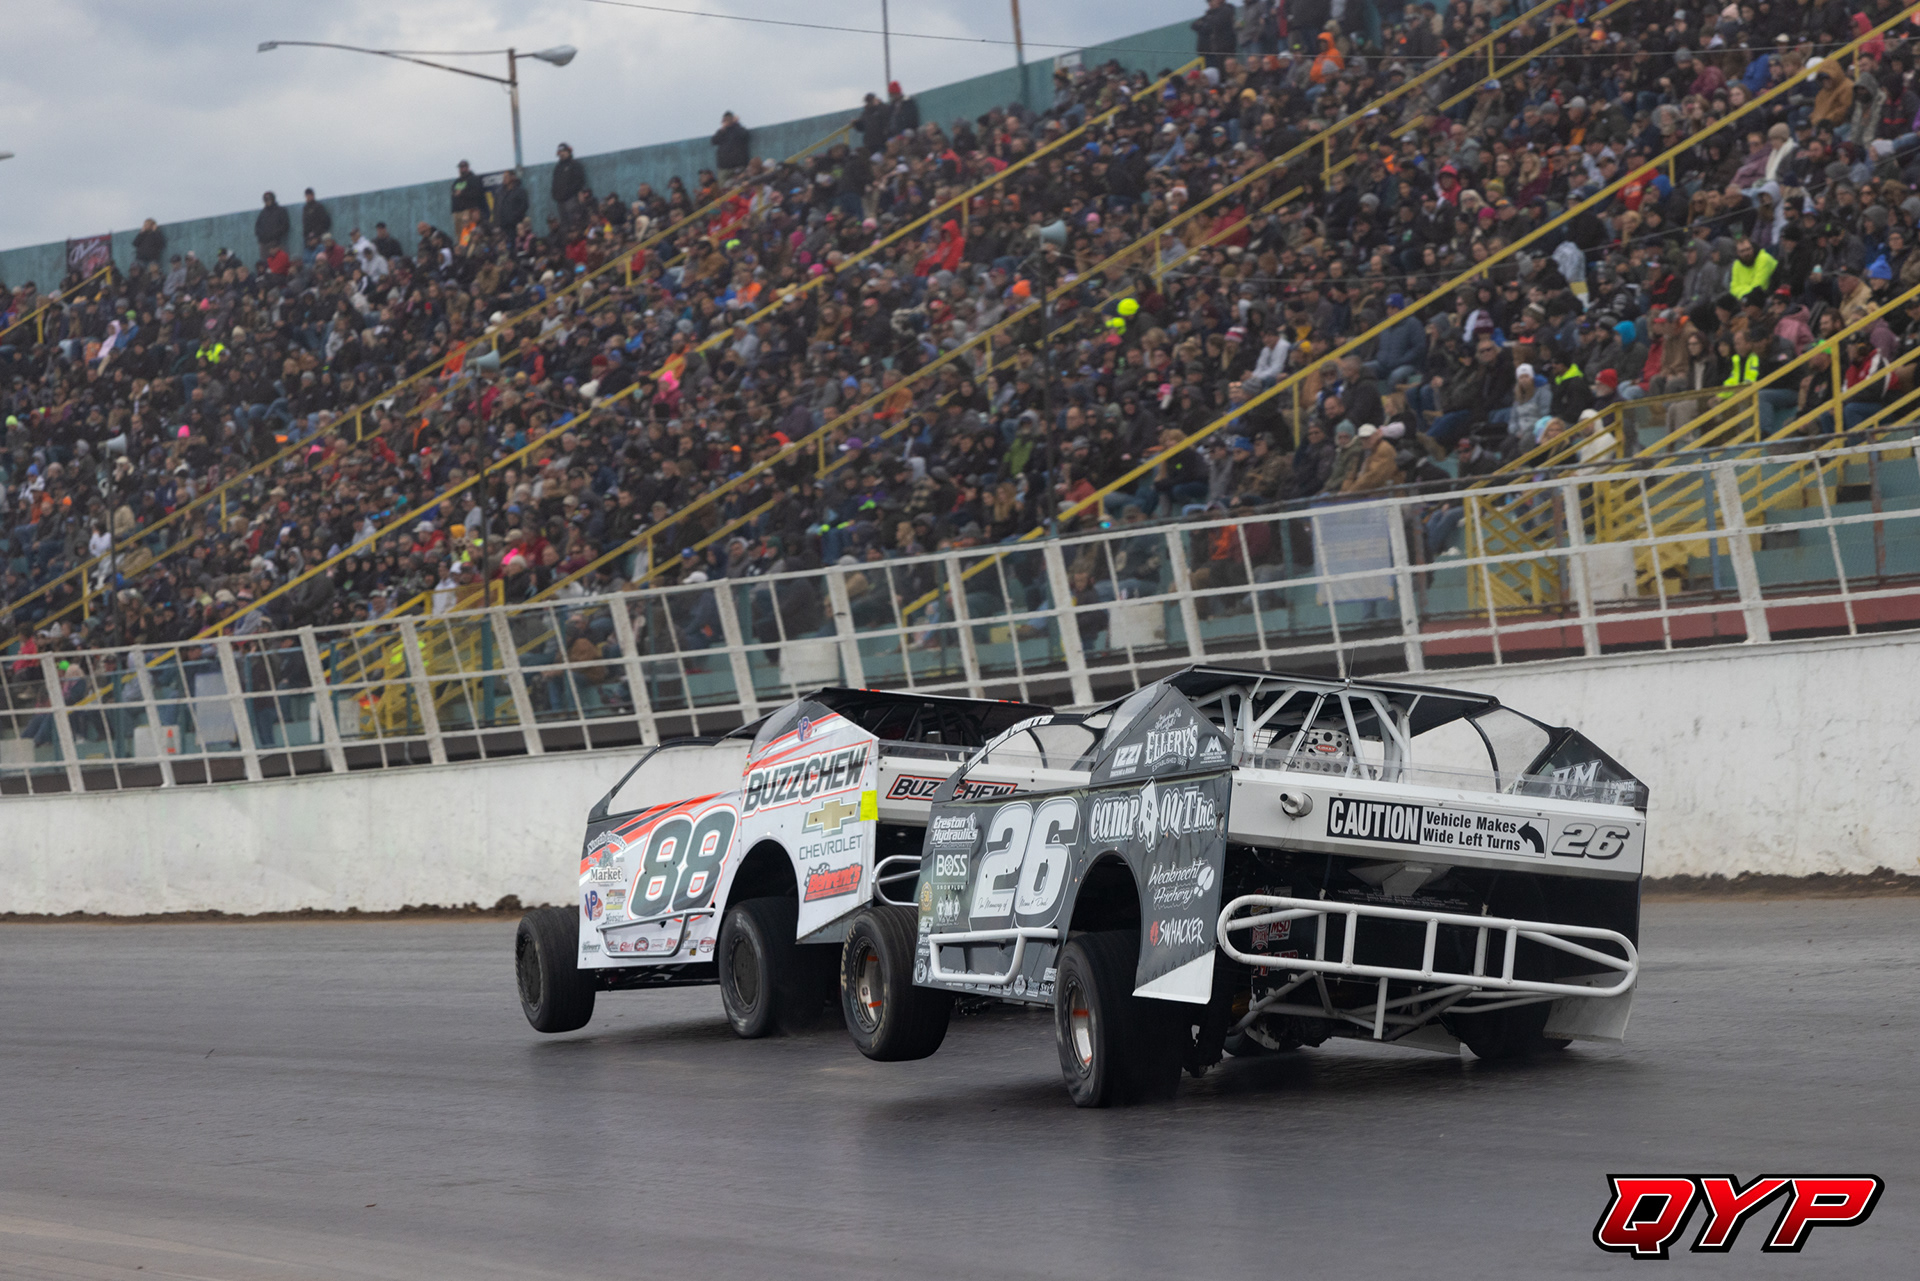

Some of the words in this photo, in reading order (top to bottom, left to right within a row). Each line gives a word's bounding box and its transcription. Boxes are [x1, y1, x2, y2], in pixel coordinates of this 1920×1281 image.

[1145, 723, 1198, 764] ELLERY'S
[743, 745, 869, 813] BUZZCHEW
[1330, 799, 1420, 842] CAUTION
[1426, 810, 1471, 829] Vehicle
[1476, 815, 1517, 834] Makes
[799, 834, 864, 860] CHEVROLET
[932, 829, 978, 844] Hydraulics
[1423, 827, 1454, 844] Wide
[1458, 831, 1483, 847] Left
[1487, 834, 1521, 851] Turns
[1551, 822, 1630, 860] 26
[630, 807, 736, 919] 88
[936, 854, 968, 876] BOSS
[969, 799, 1078, 918] 26
[590, 867, 622, 881] Market
[585, 890, 598, 922] VP
[1153, 886, 1194, 905] Archery
[1270, 919, 1291, 935] MSD
